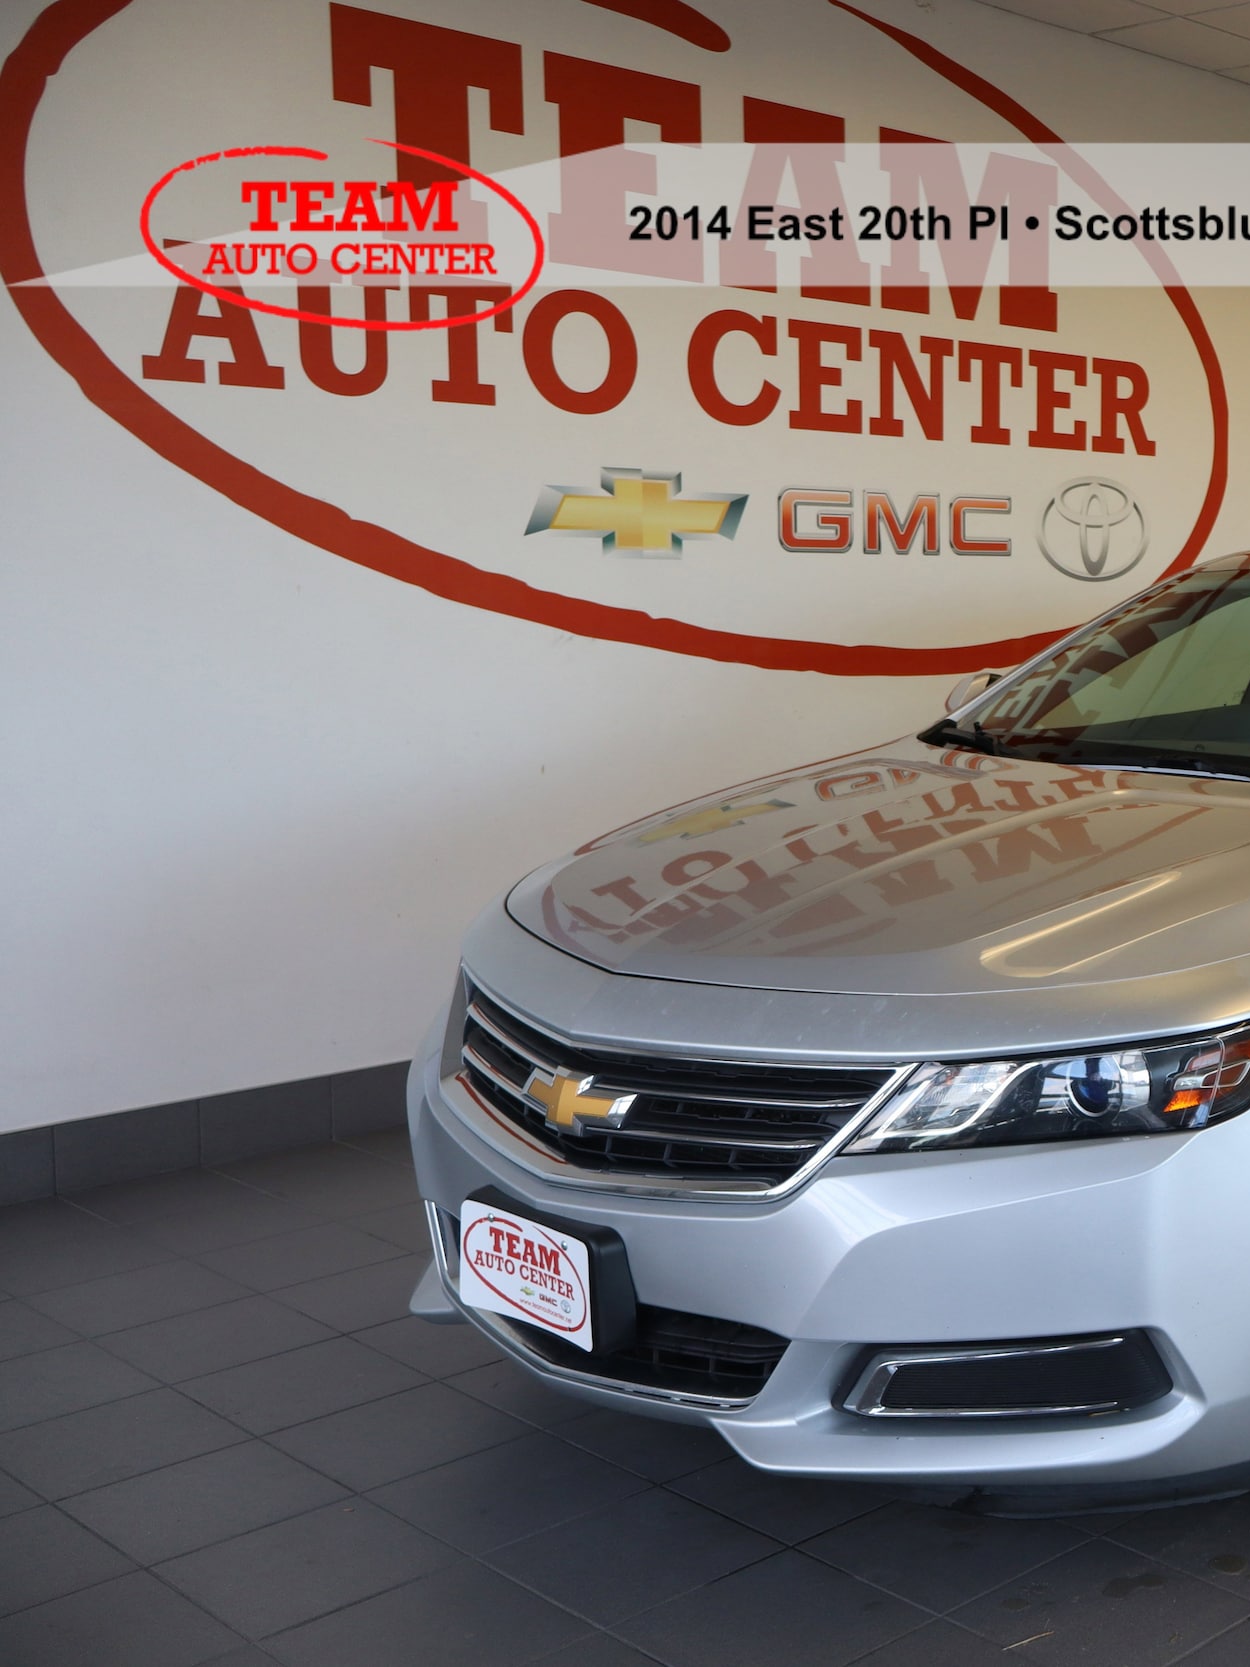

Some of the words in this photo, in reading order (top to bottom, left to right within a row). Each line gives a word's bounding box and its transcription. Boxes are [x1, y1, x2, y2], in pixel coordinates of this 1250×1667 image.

[330, 2, 1058, 332] TEAM
[141, 238, 638, 415] AUTO
[687, 308, 1157, 457] CENTER
[777, 487, 1012, 557] GMC
[474, 1249, 515, 1276] AUTO
[519, 1264, 575, 1301] CENTER
[489, 1226, 561, 1276] TEAM
[538, 1293, 558, 1307] GMC
